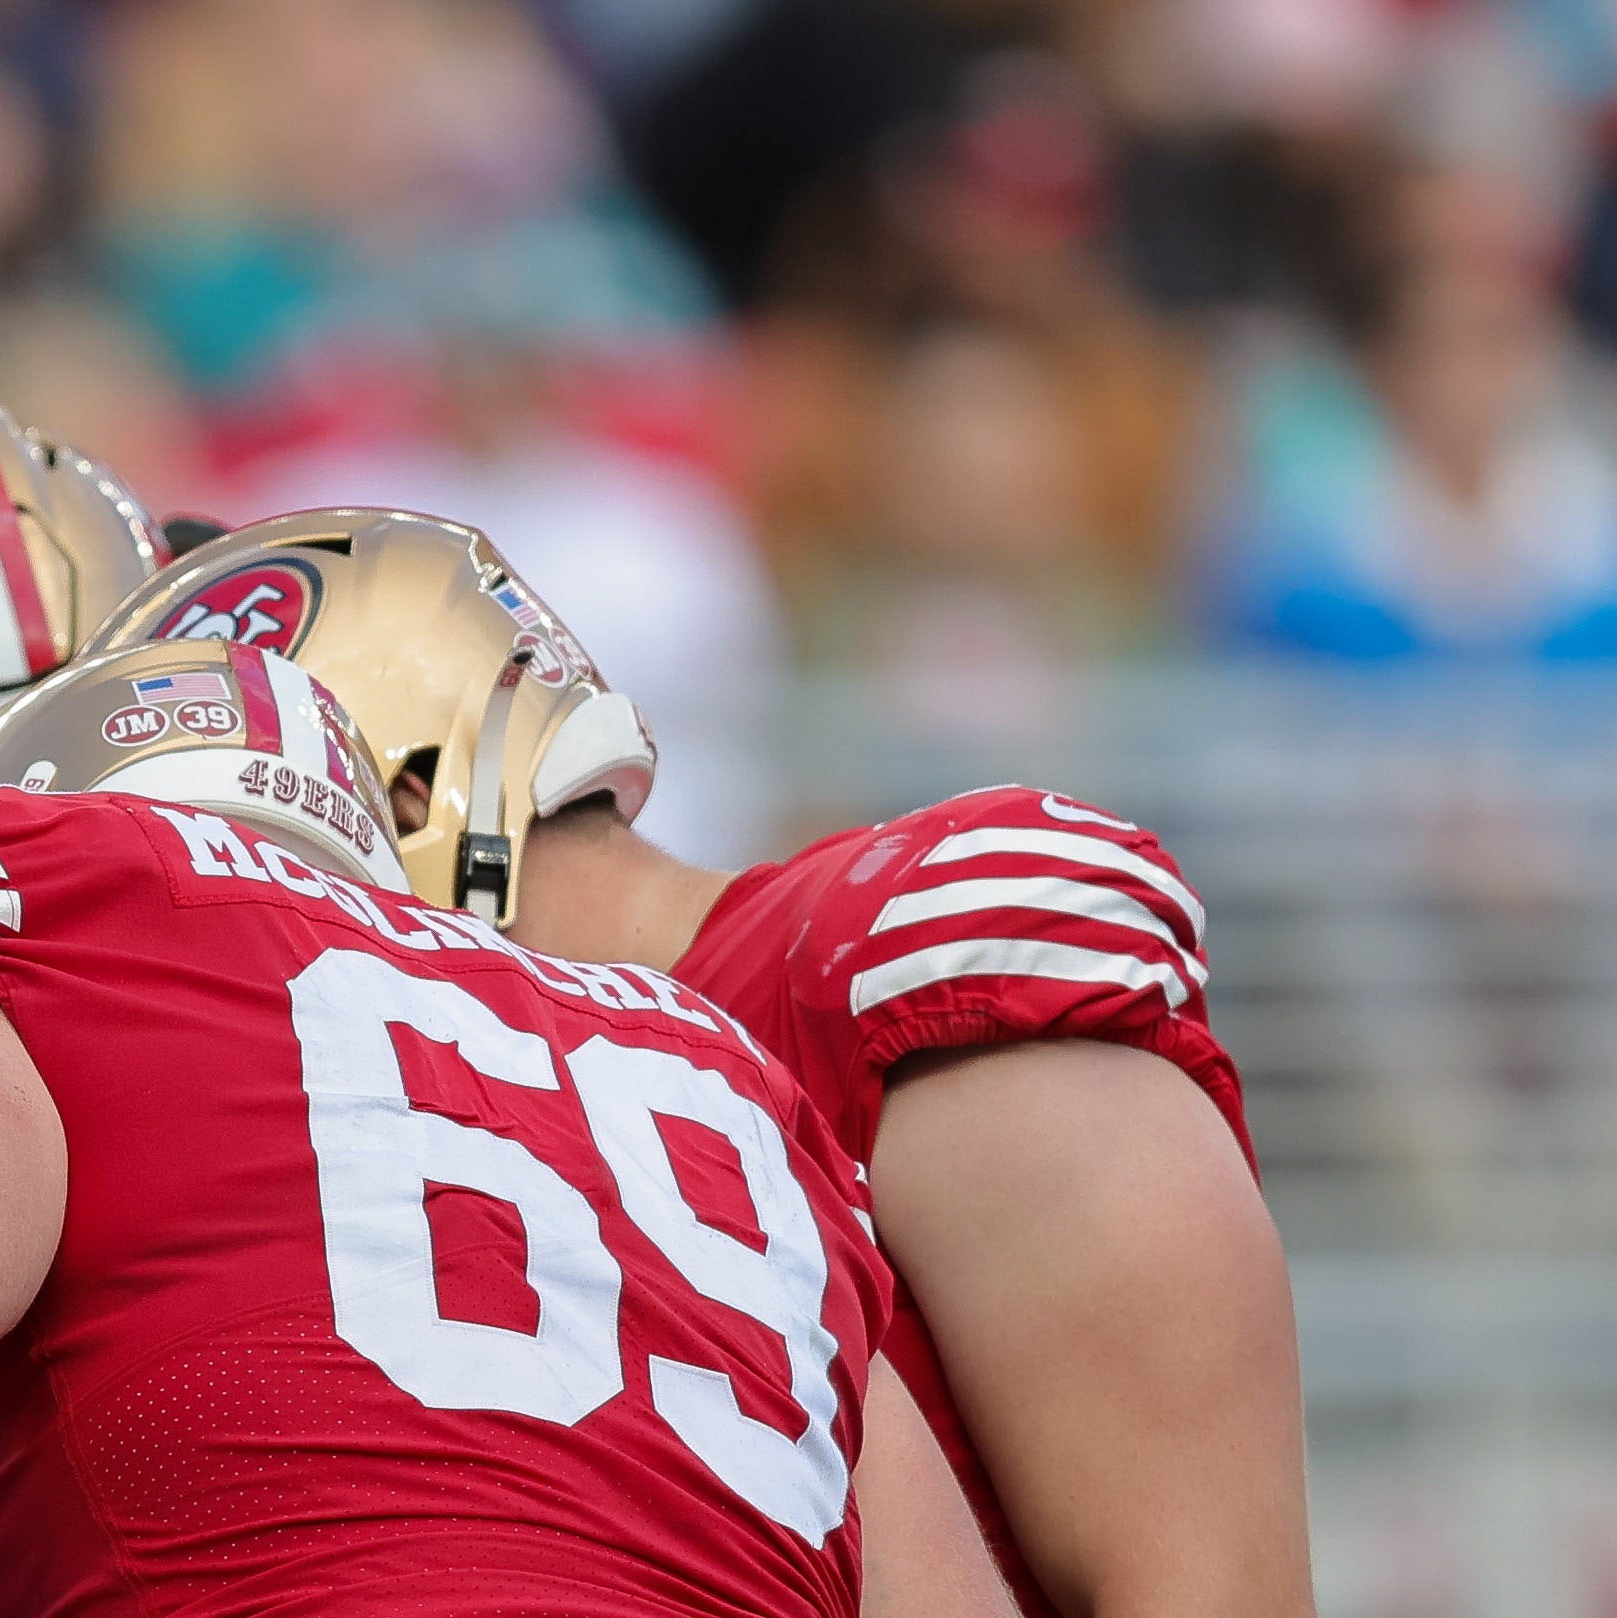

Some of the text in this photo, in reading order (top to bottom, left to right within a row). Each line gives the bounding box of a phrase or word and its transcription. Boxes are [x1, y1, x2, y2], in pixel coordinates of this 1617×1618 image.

[111, 705, 231, 740] JM 39
[238, 759, 375, 854] 49ERS
[286, 947, 850, 1551] 69
